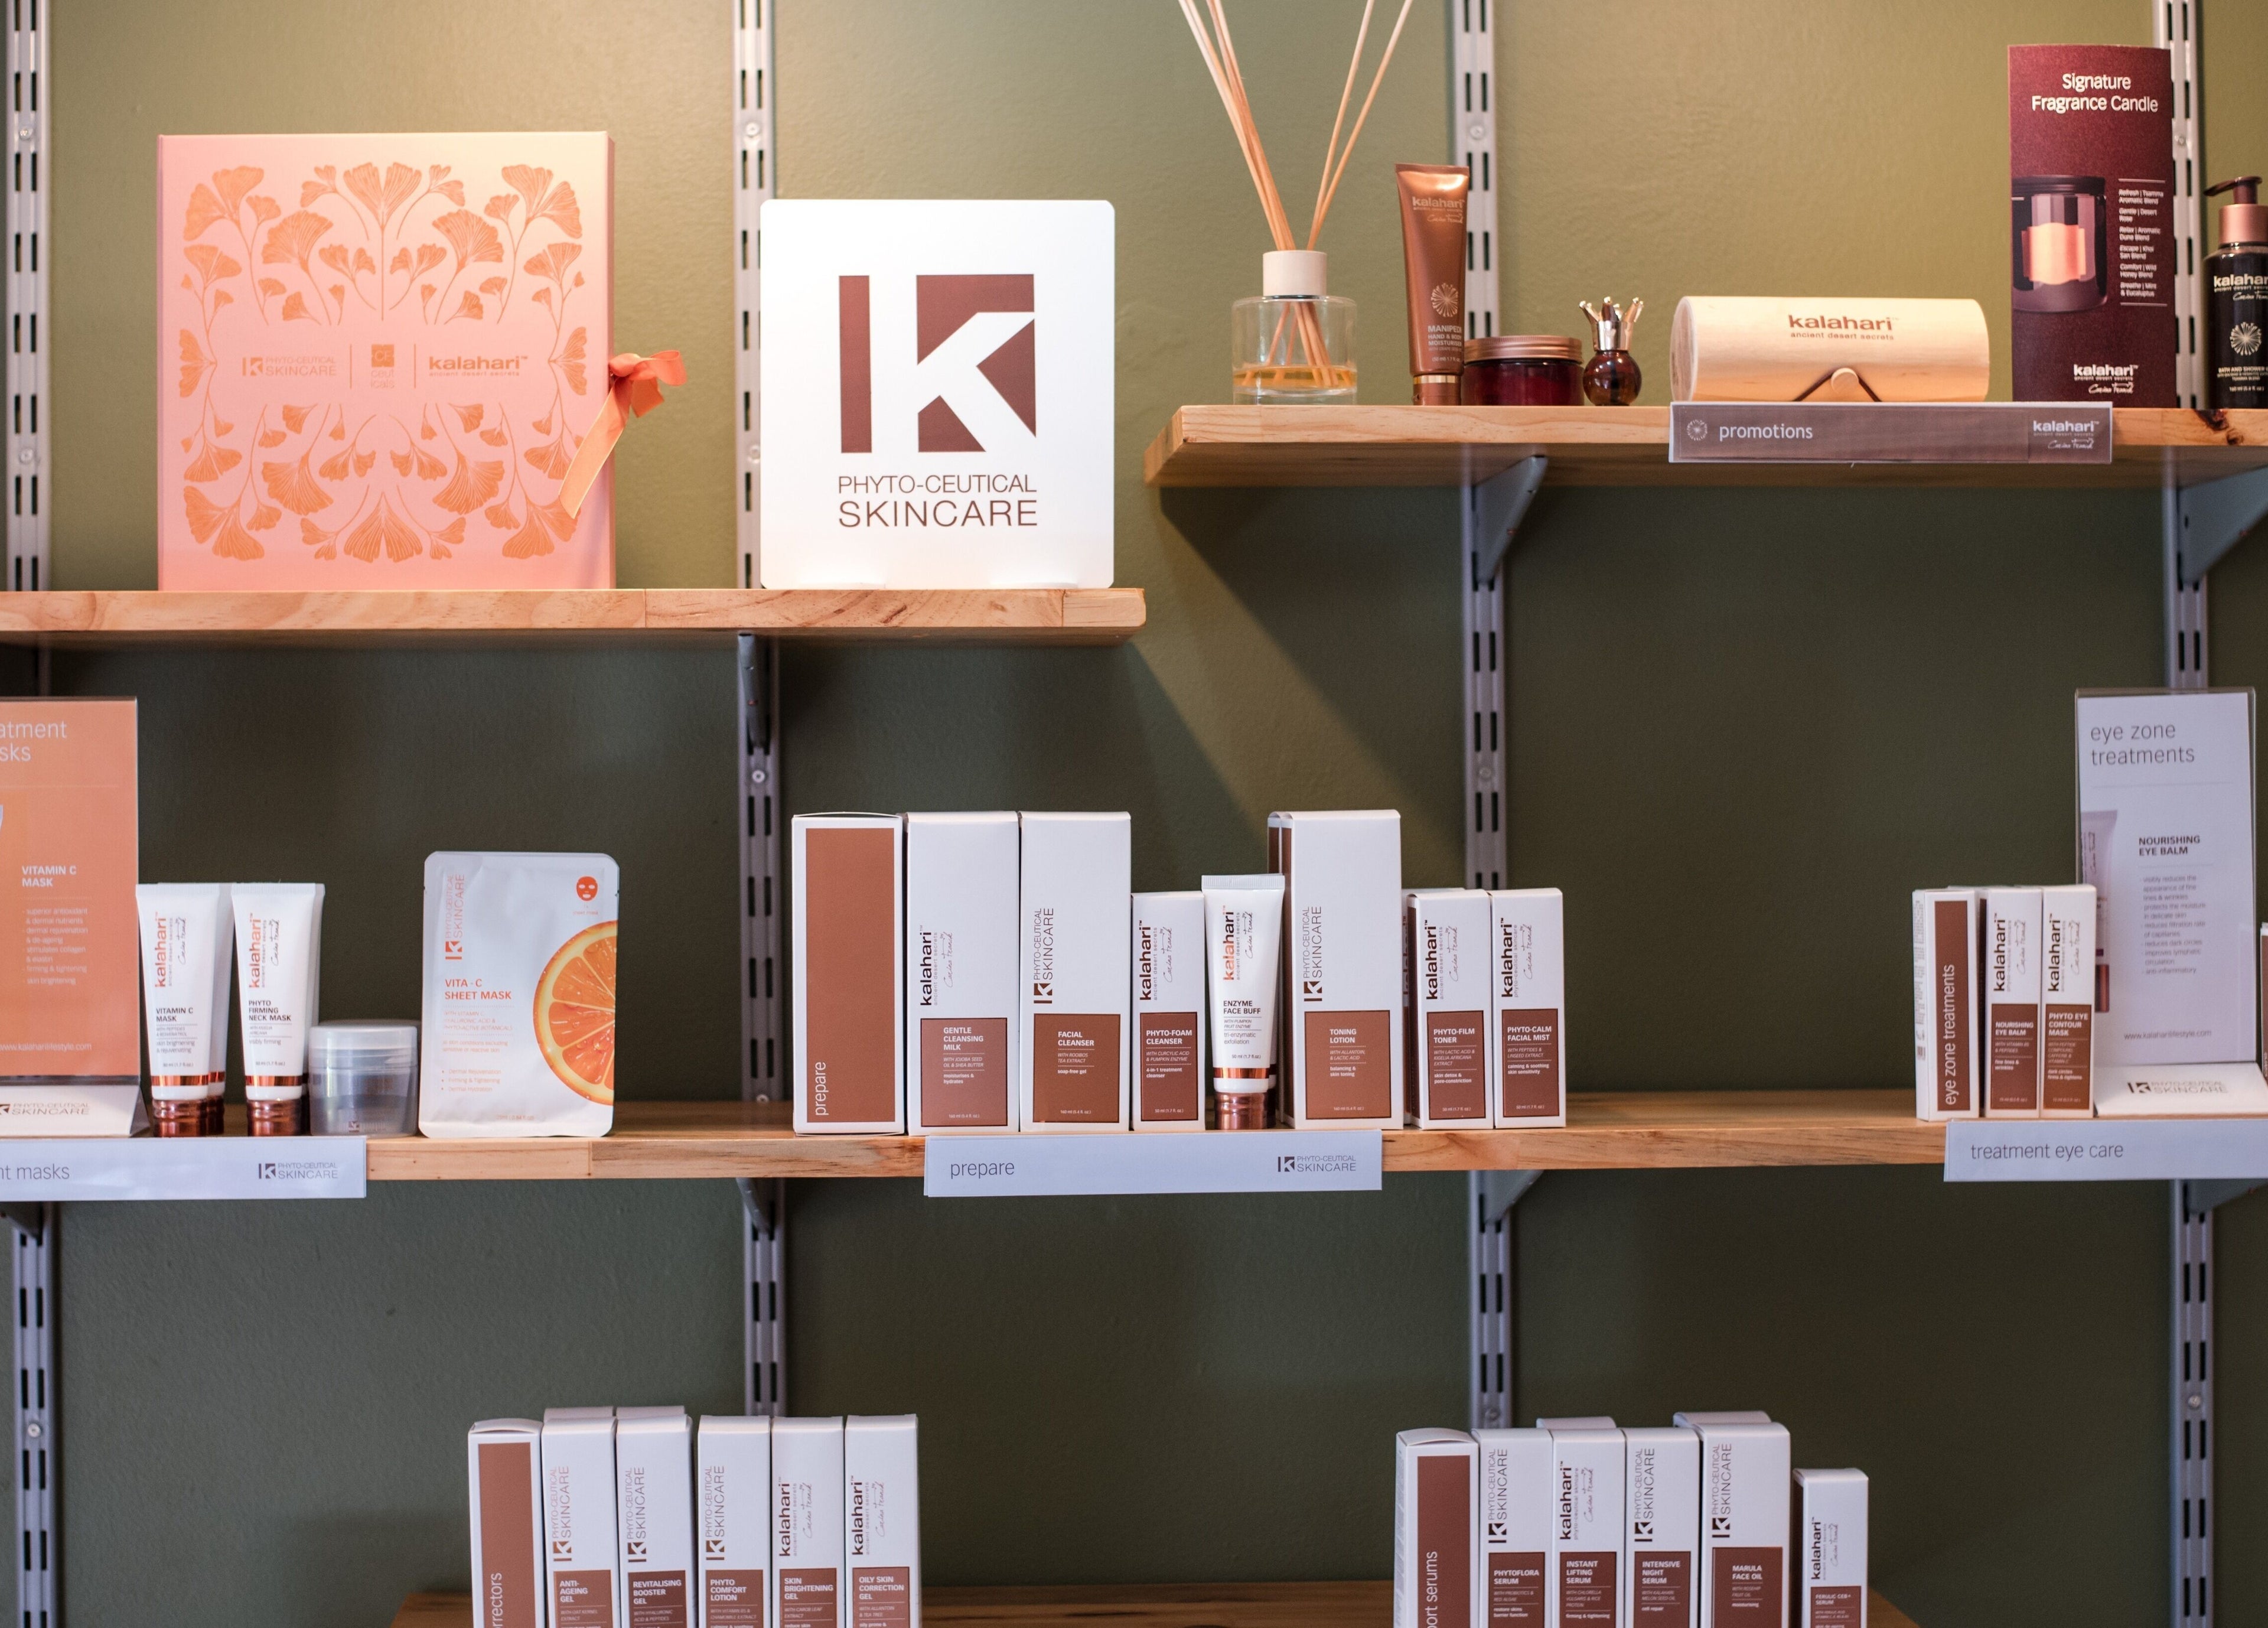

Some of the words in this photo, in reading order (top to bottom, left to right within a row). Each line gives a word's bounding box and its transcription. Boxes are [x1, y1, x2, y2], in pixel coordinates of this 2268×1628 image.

[2062, 73, 2132, 92] Signature
[2032, 95, 2107, 114] Fragrance
[2111, 95, 2159, 113] Candle
[266, 366, 337, 376] SKINCARE
[1719, 423, 1813, 442] promotions
[839, 474, 1037, 494] PHYTO-CEUTICAL
[839, 500, 1037, 528] SKINCARE
[2091, 725, 2123, 745] eye
[2131, 724, 2176, 740] zone
[2091, 747, 2195, 766] treatments
[2139, 835, 2201, 845] NOURISHING
[2139, 848, 2156, 857] EYE
[2160, 846, 2188, 856] BALM
[21, 865, 67, 875] VITAMIN
[69, 865, 77, 875] C
[21, 878, 53, 887] MASK
[453, 874, 465, 939] SKINCARE
[1034, 908, 1042, 981] PHYTO-CEUTICAL
[1043, 907, 1054, 981] SKINCARE
[1312, 906, 1322, 978] SKINCARE
[445, 978, 468, 988] VITA
[475, 978, 483, 988] C
[444, 991, 477, 1001] SHEET
[480, 991, 512, 1000] MASK
[1943, 964, 1956, 1039] treatments
[1507, 1025, 1552, 1034] PHYTO-CALM
[1944, 1043, 1956, 1077] zone
[815, 1062, 829, 1116] prepare
[1945, 1080, 1959, 1105] eye
[1970, 1143, 2051, 1160] treatment
[2055, 1145, 2084, 1161] eye
[2089, 1144, 2124, 1158] care
[17, 1163, 70, 1180] masks
[278, 1170, 338, 1179] SKINCARE
[950, 1160, 1015, 1179] prepare
[1297, 1163, 1357, 1172] SKINCARE
[1497, 1448, 1508, 1520] SKINCARE
[1634, 1448, 1643, 1519] PHYTO-CEUTICAL
[1644, 1448, 1654, 1519] SKINCARE
[1721, 1443, 1732, 1515] SKINCARE
[550, 1467, 559, 1538] PHYTO-CEUTICAL
[559, 1466, 572, 1538] SKINCARE
[625, 1467, 634, 1539] PHYTO-CEUTICAL
[634, 1467, 646, 1539] SKINCARE
[714, 1465, 725, 1537] SKINCARE
[633, 1580, 682, 1588] REVITALISING
[1426, 1551, 1438, 1603] serums
[490, 1572, 503, 1628] rrectors
